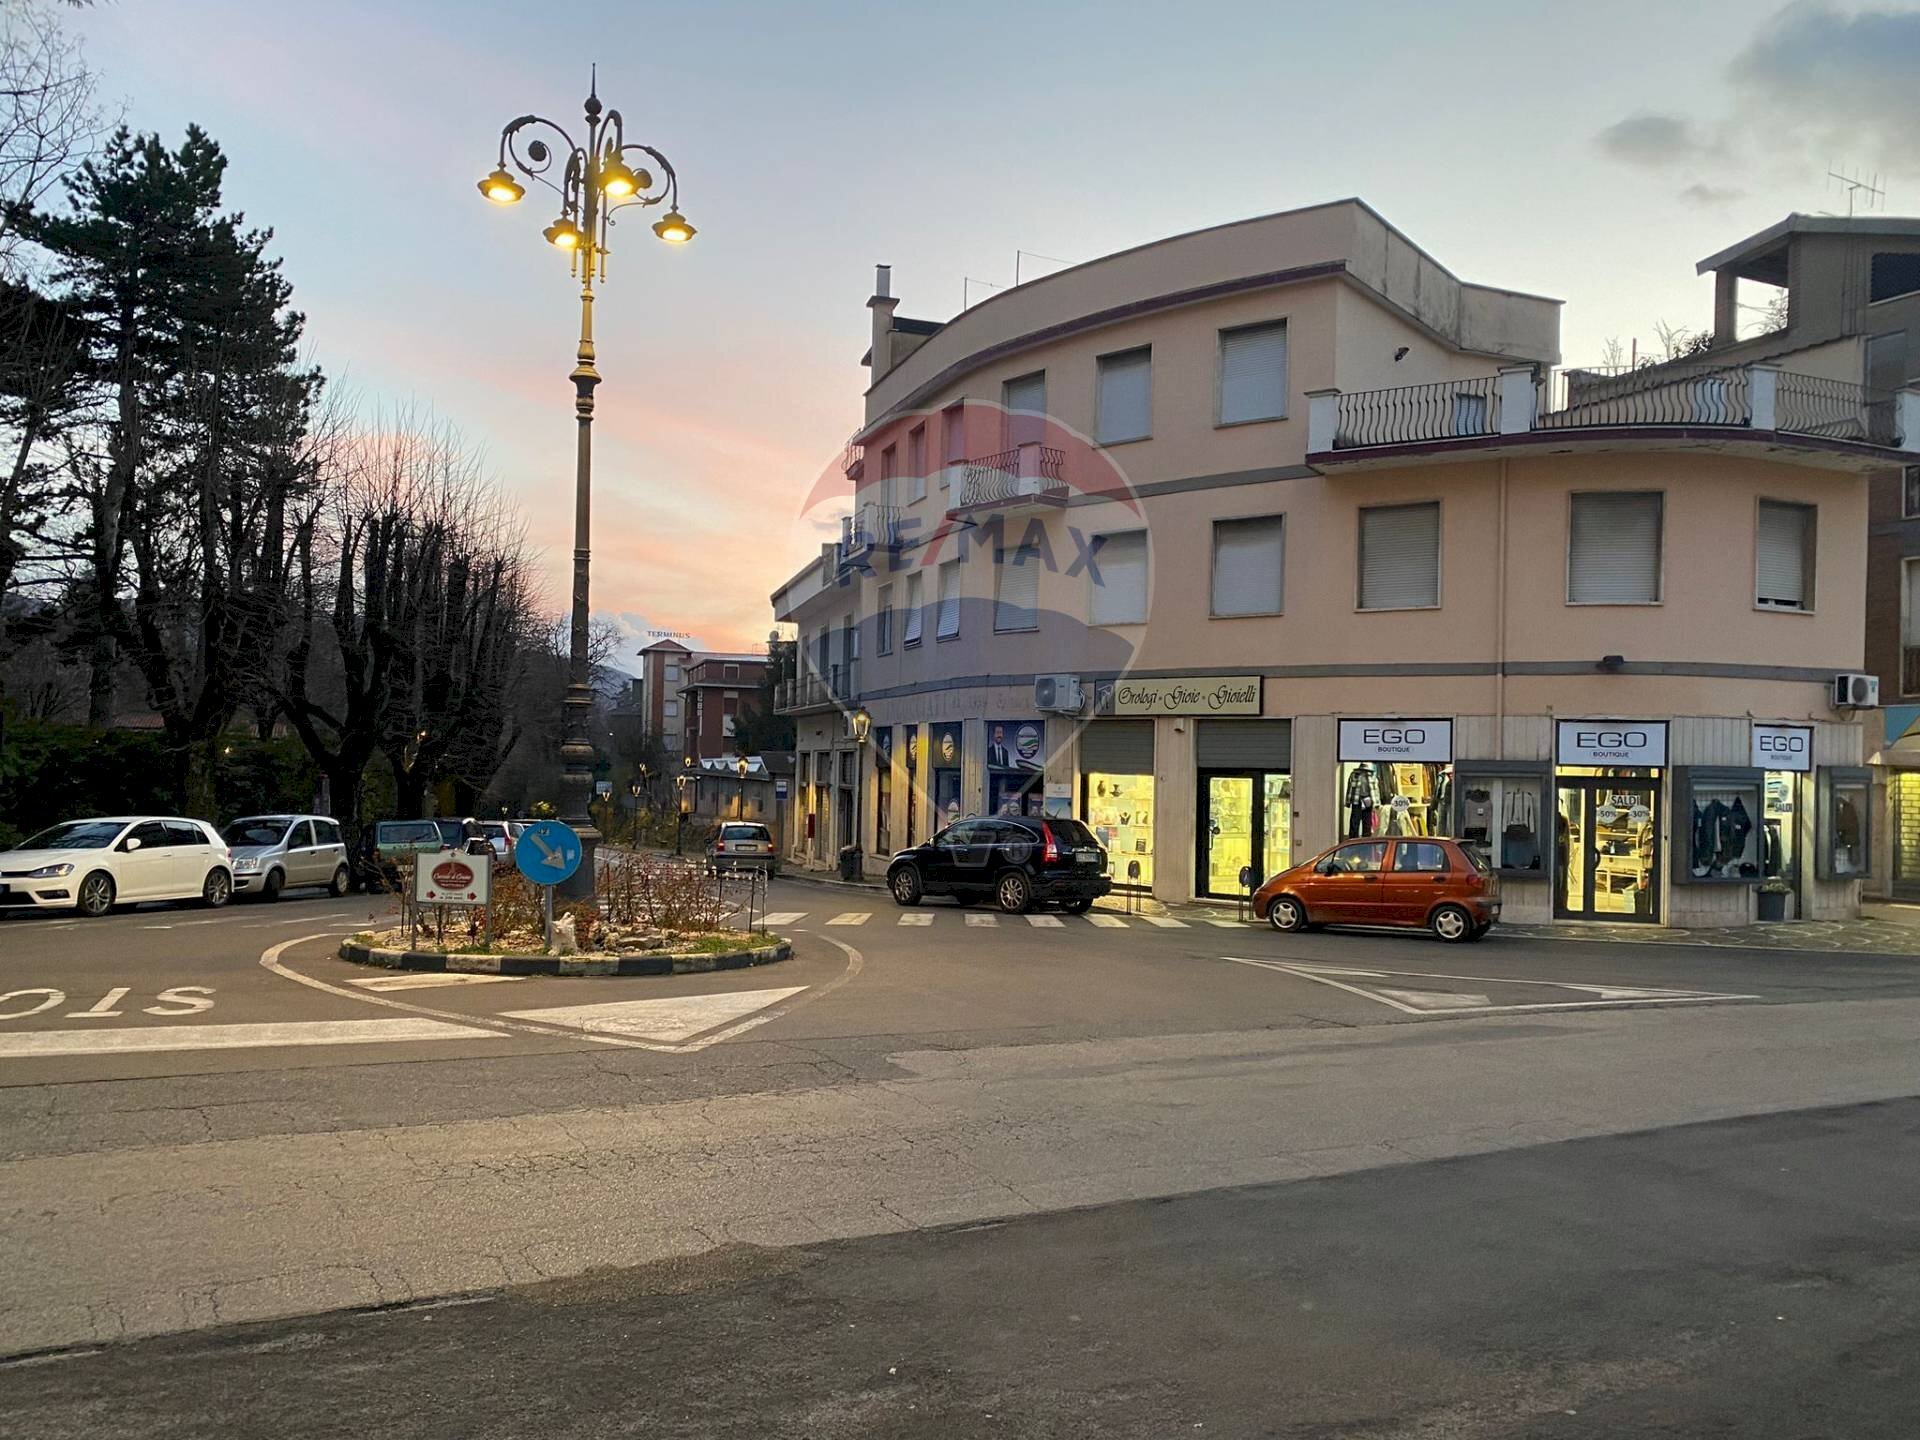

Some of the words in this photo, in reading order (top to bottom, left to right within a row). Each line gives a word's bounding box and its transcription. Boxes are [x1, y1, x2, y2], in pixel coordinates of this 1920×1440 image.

[646, 630, 690, 639] TERMINUS
[1118, 687, 1159, 710] Orologi
[1163, 685, 1201, 710] Gioie
[1207, 684, 1257, 710] Gioielli
[1363, 728, 1426, 744] EGO
[1576, 731, 1648, 748] EGO
[1759, 735, 1804, 752] EGO
[1611, 795, 1640, 806] SALDI
